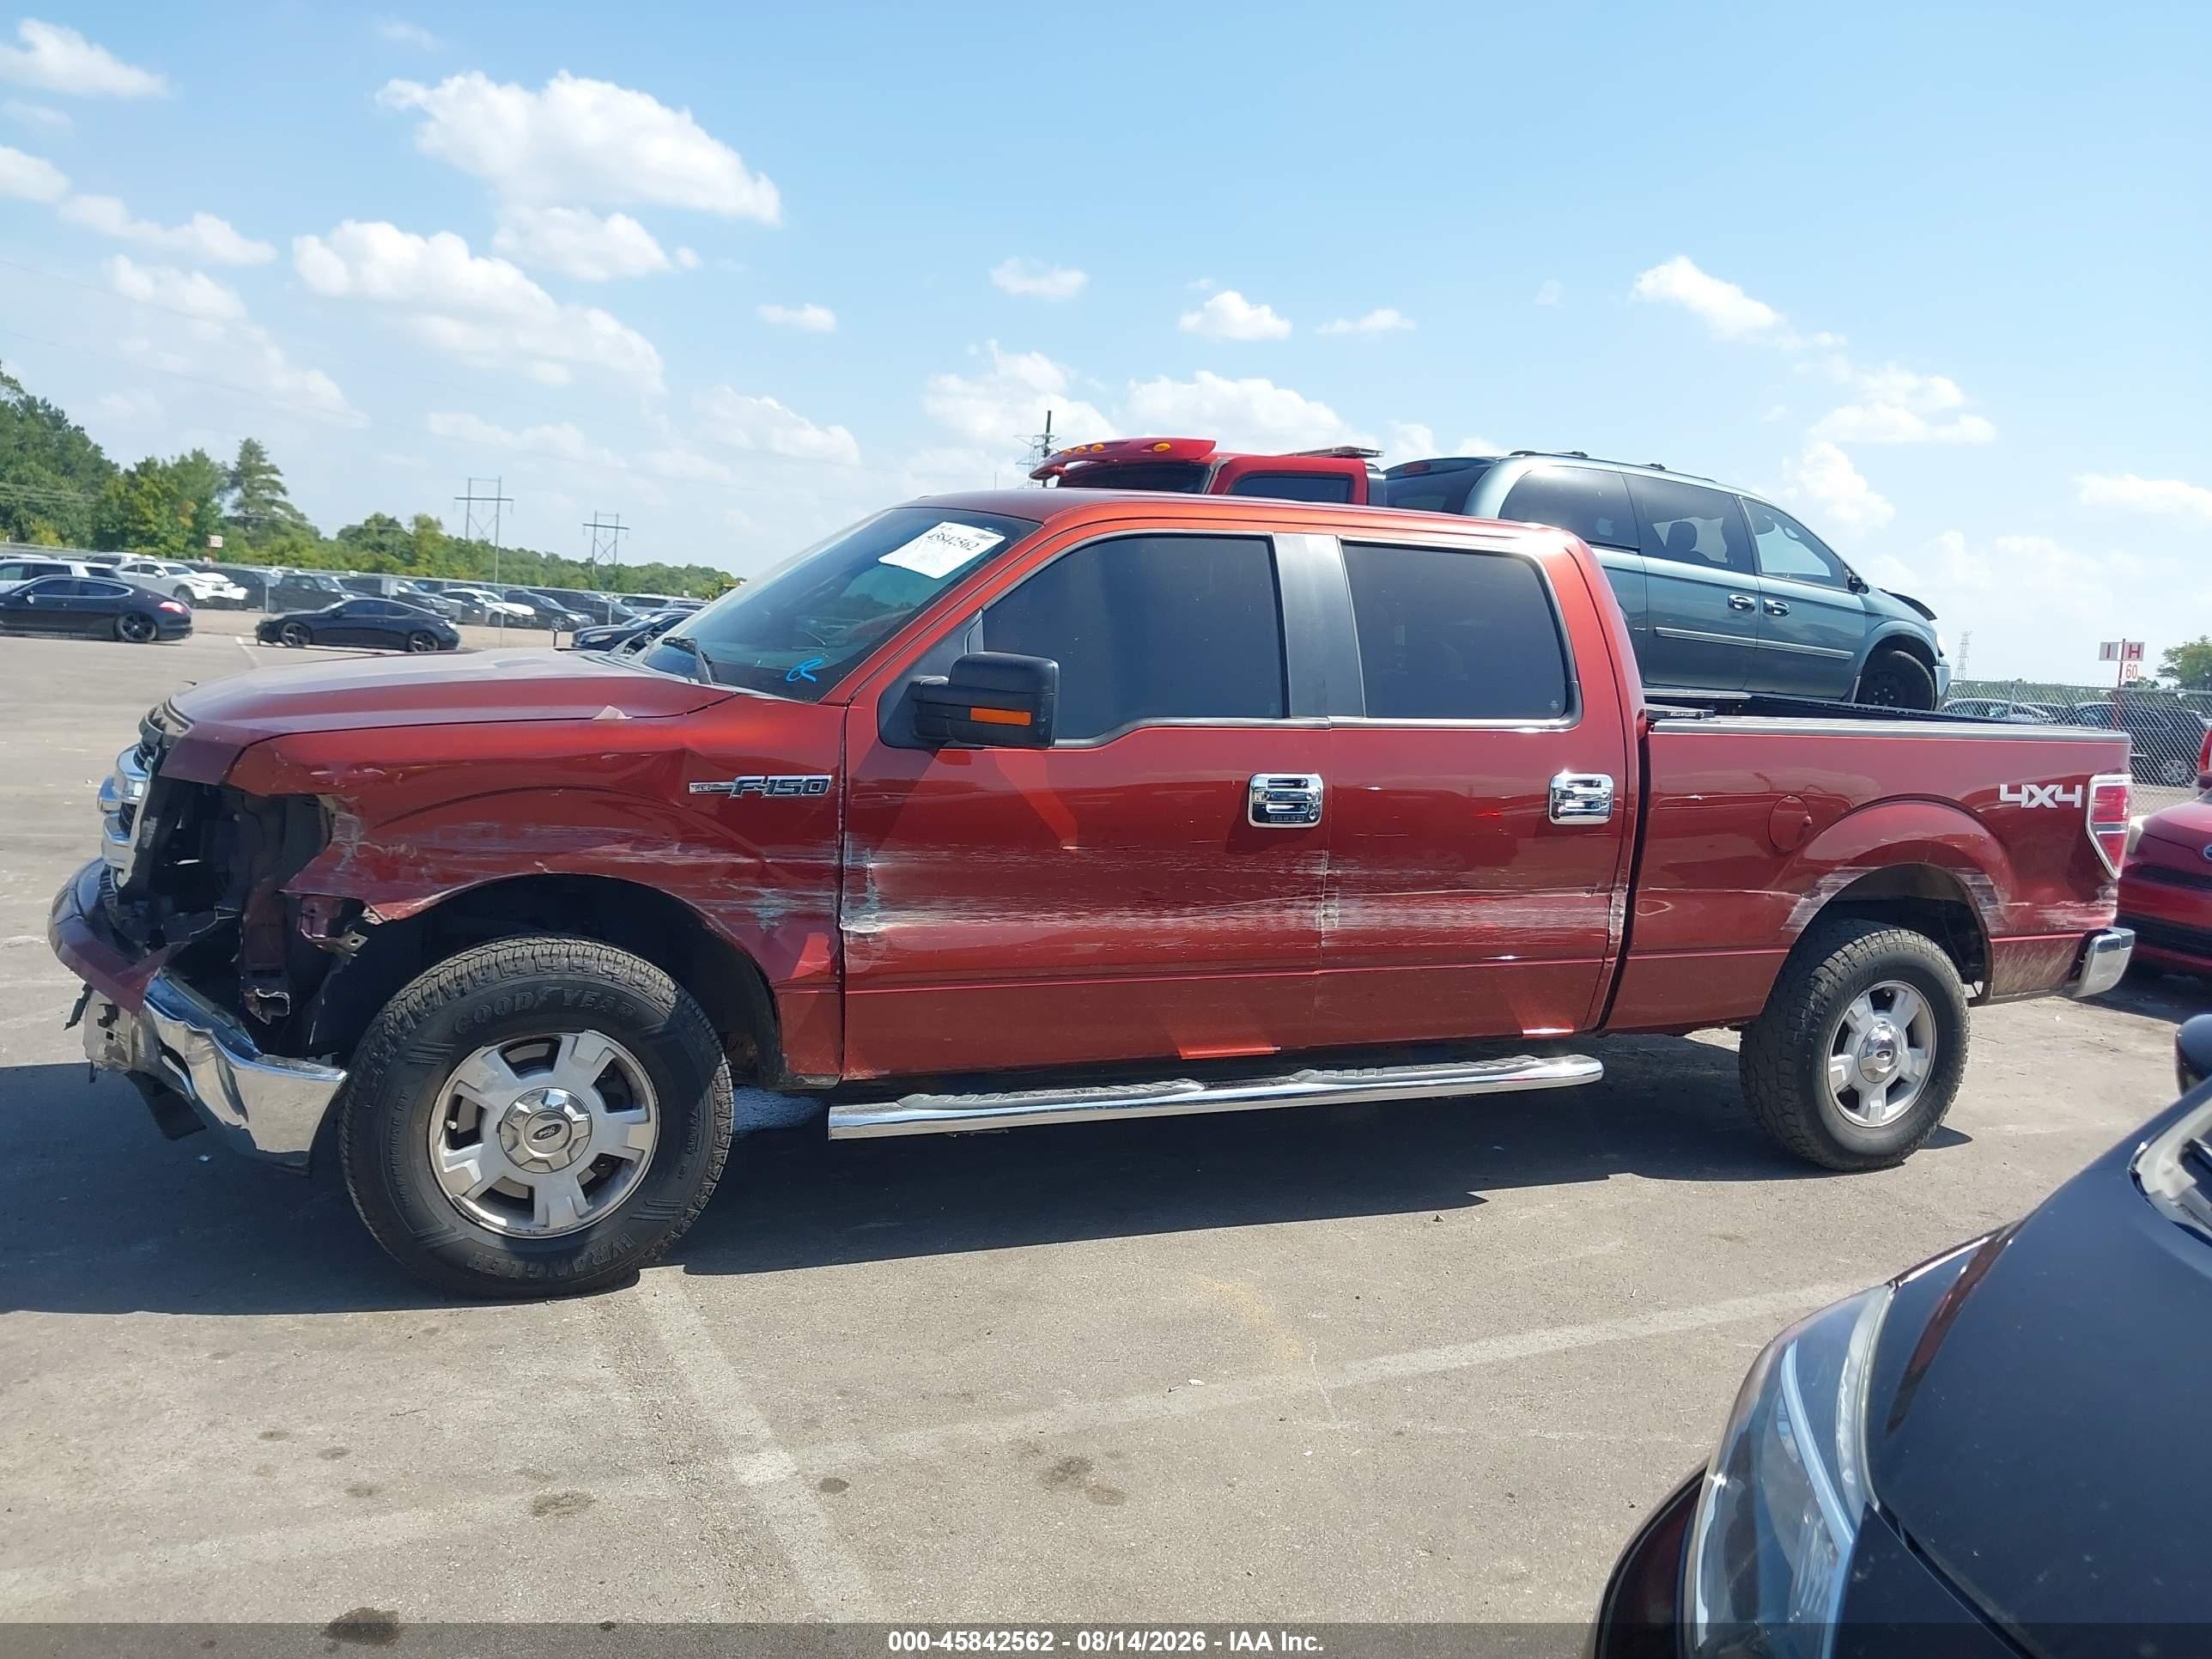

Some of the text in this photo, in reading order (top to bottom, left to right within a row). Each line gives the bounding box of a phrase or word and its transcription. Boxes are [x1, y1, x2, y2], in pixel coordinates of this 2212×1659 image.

[2127, 643, 2142, 659] H
[2125, 663, 2138, 679] 60
[728, 775, 833, 799] F-150
